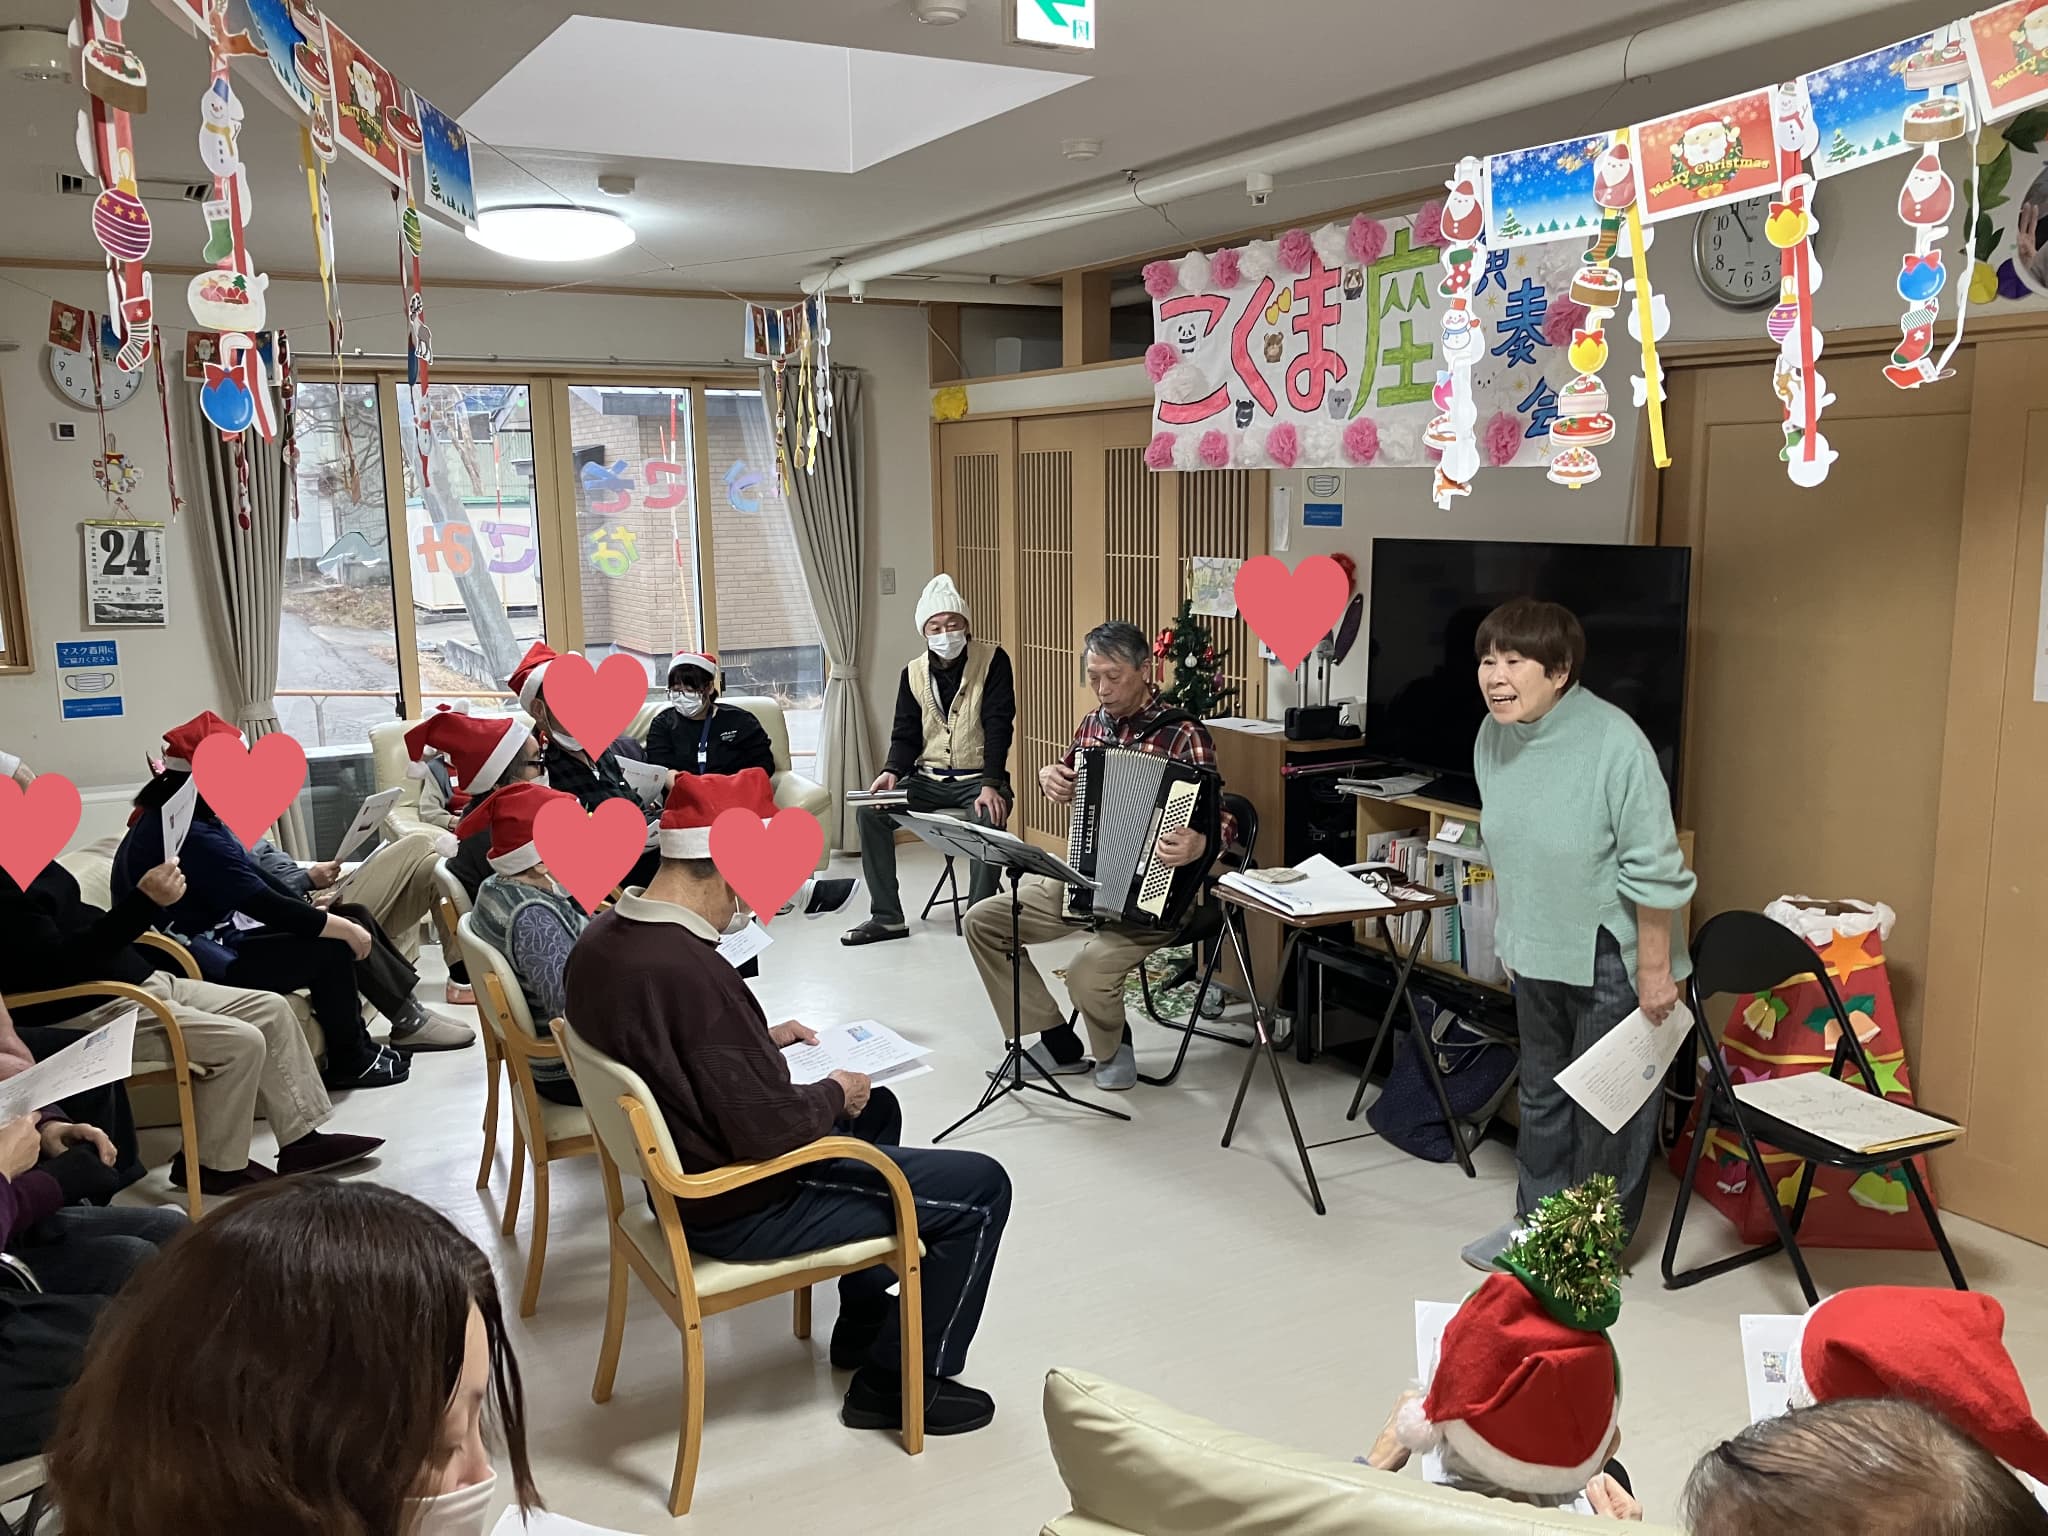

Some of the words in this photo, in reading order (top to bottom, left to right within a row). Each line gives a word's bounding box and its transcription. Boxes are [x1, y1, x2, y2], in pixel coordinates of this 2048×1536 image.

[1648, 169, 1690, 198] Merry
[1694, 157, 1770, 175] Christmas
[1717, 214, 1729, 231] 10
[1713, 235, 1722, 251] 9
[1715, 254, 1724, 270] 8
[1728, 268, 1736, 284] 7
[1744, 271, 1753, 288] 6
[1761, 265, 1771, 281] 5
[58, 361, 66, 371] 9
[65, 376, 73, 387] 8
[80, 388, 88, 398] 7
[113, 389, 121, 400] 5
[100, 529, 151, 576] 24
[61, 645, 115, 656] マスク着用に
[1085, 804, 1096, 855] EXCELSIOR
